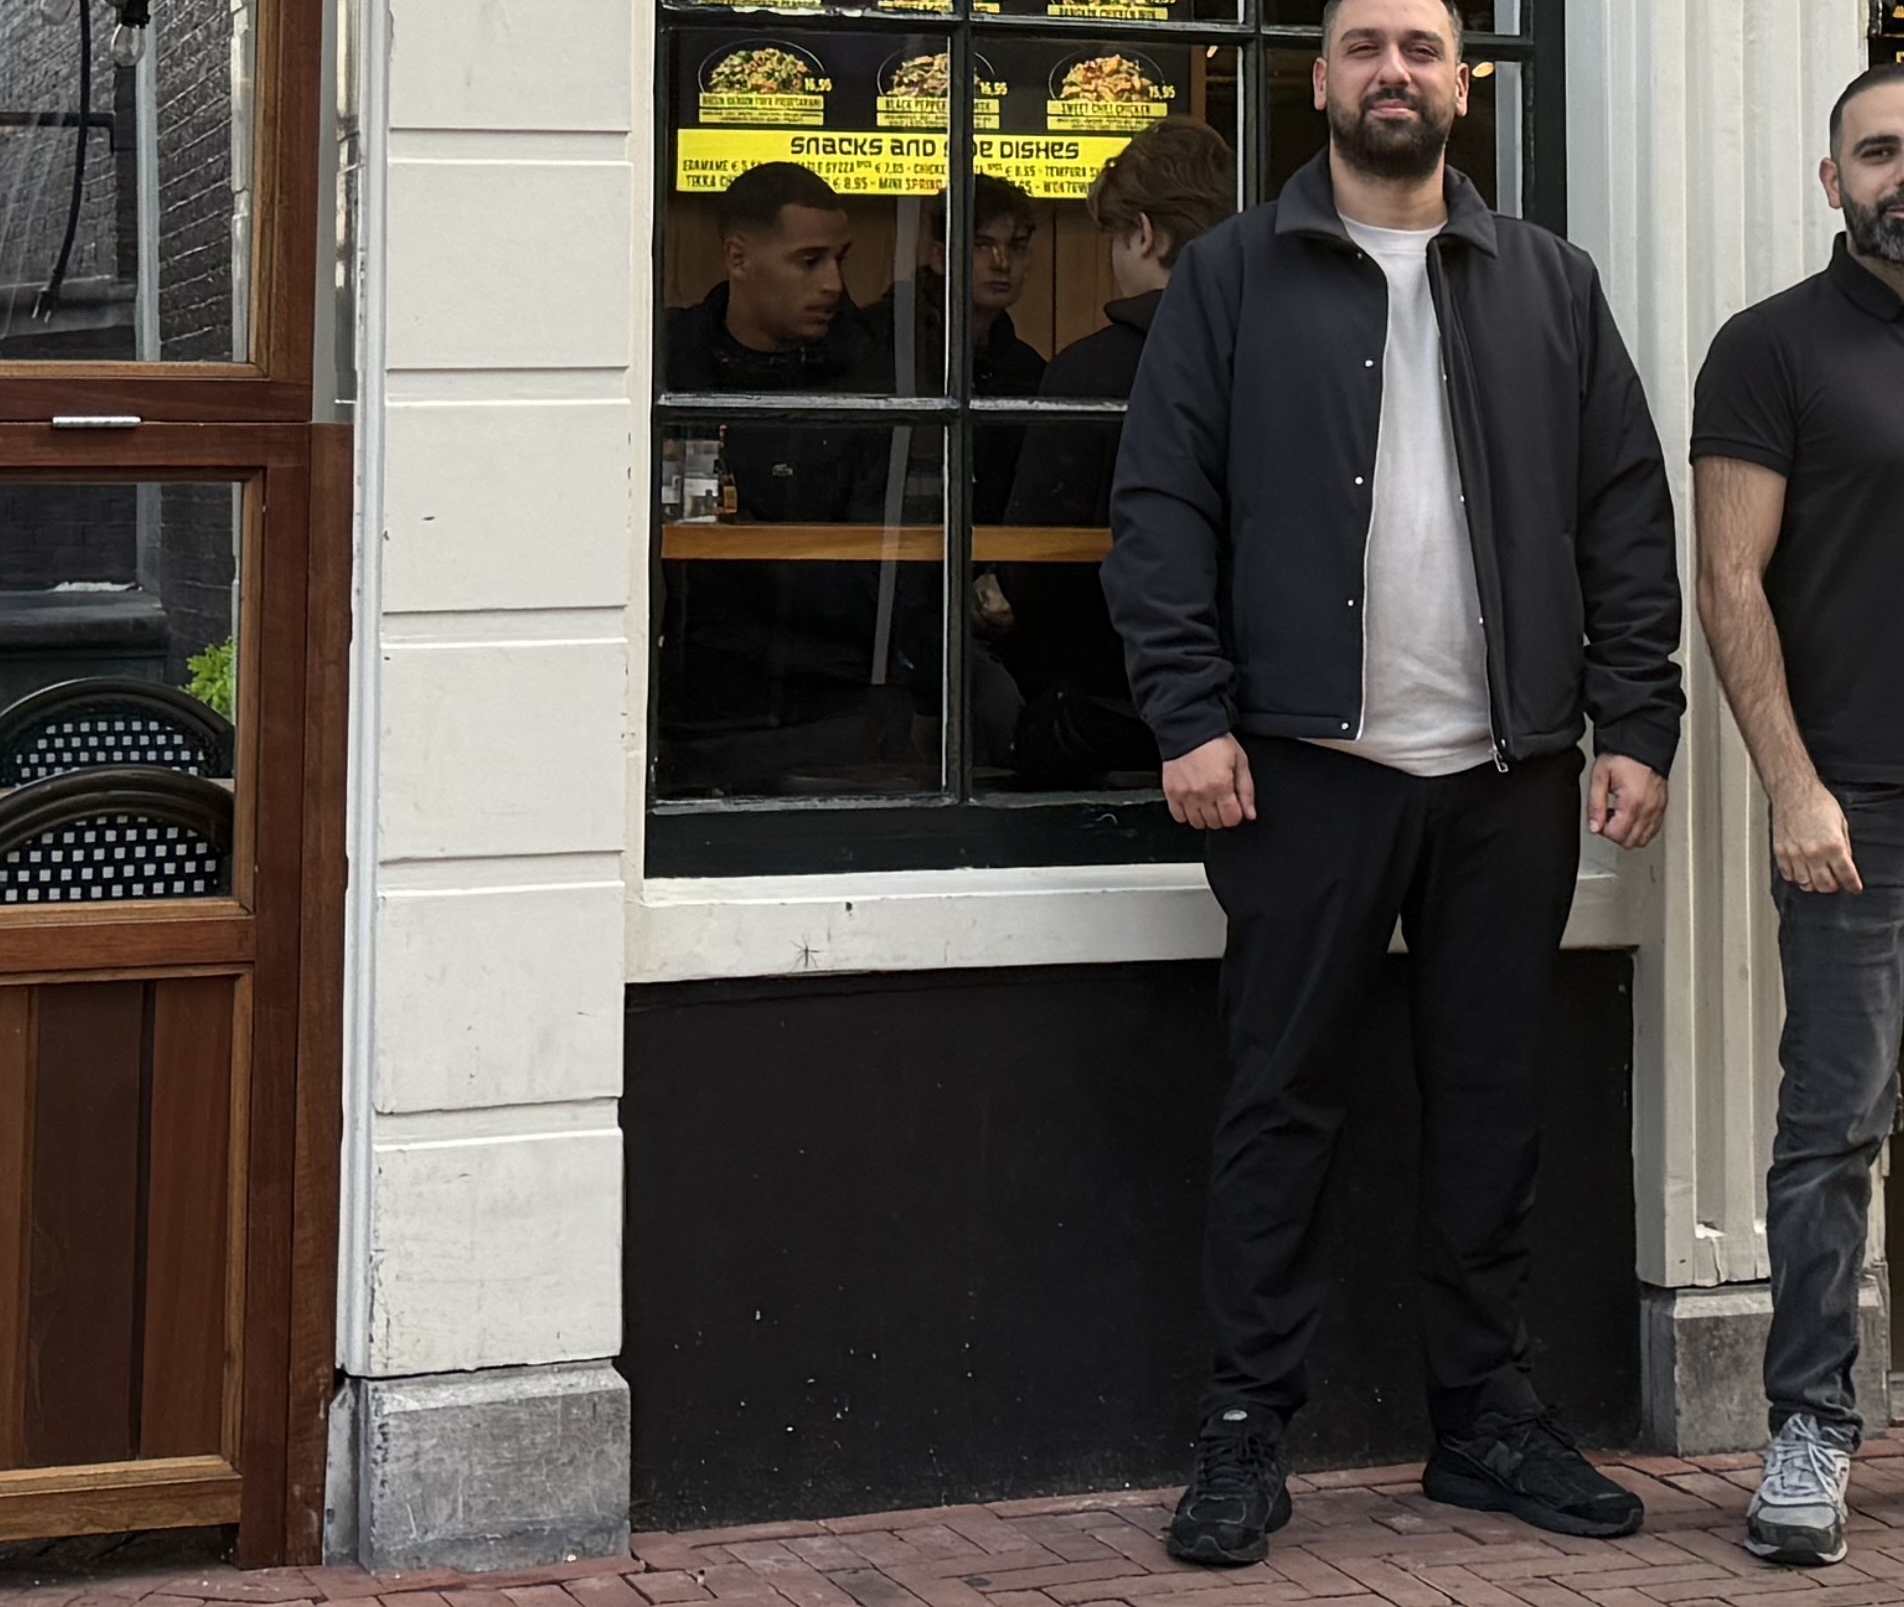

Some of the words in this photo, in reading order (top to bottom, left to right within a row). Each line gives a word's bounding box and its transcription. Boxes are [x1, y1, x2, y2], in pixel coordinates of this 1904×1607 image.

[791, 136, 883, 156] SNACKS
[891, 138, 936, 157] AND
[1000, 142, 1079, 159] DISHES
